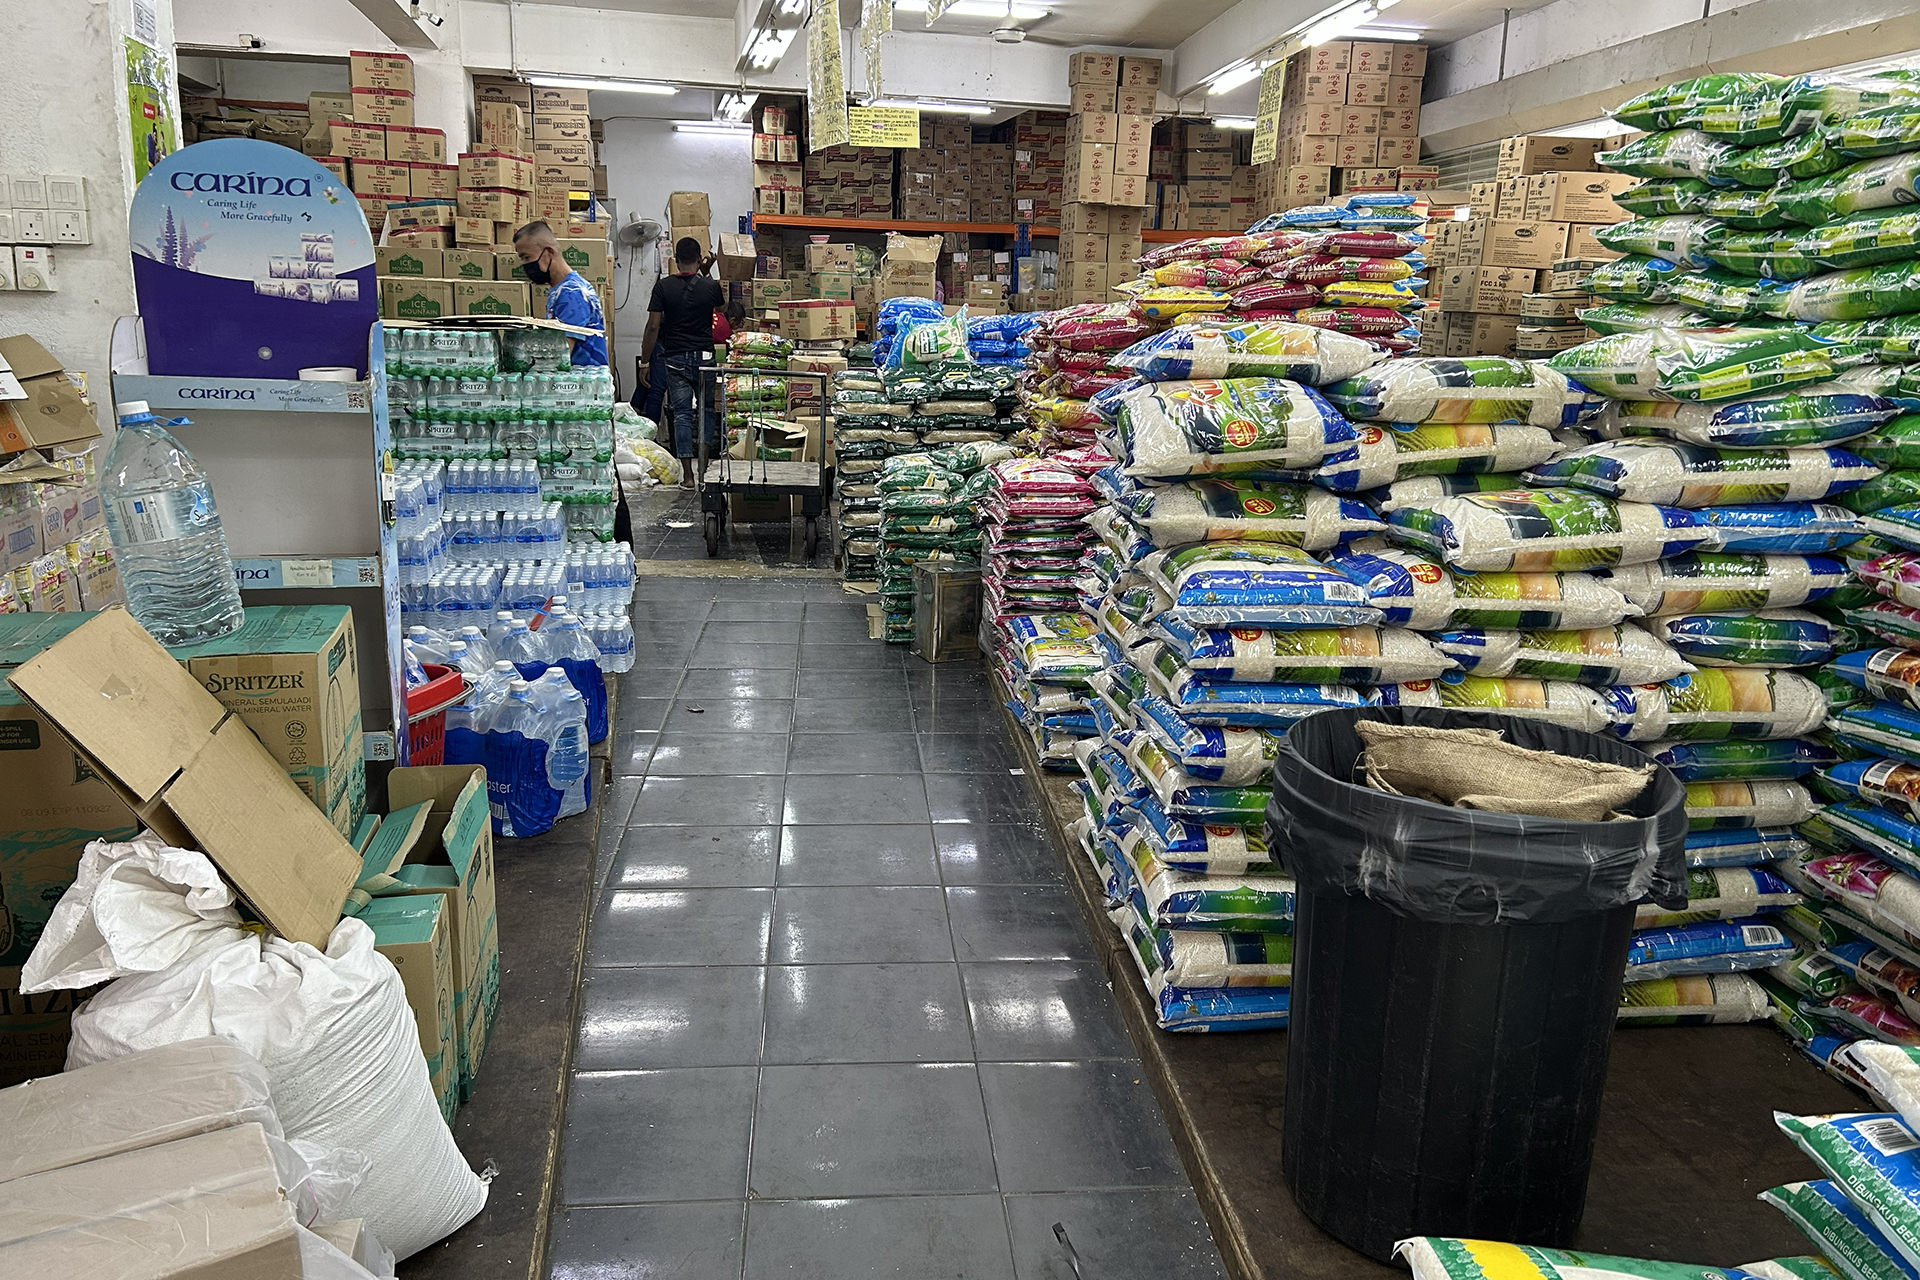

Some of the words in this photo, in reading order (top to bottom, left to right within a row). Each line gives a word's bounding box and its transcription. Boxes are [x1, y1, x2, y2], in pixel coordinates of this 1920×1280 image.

[207, 199, 237, 210] Caring
[240, 200, 257, 210] Life
[221, 211, 244, 220] More
[246, 212, 292, 224] Gracefully
[411, 300, 426, 308] ICE
[482, 302, 497, 310] ICE
[401, 308, 438, 316] MOUNTAIN
[429, 338, 463, 346] SPRITZER
[458, 382, 491, 390] SPRITZER
[270, 388, 289, 396] Caring
[294, 396, 324, 404] Gracefully
[550, 468, 582, 476] SPRITZER
[206, 673, 304, 694] SPRITZER
[258, 696, 312, 705] SEMULAJADI
[243, 706, 282, 714] MINERAL
[282, 705, 312, 713] WATER
[1847, 1174, 1900, 1227] DIBUNGKUS
[1823, 1226, 1863, 1268] DIBUNGKUS
